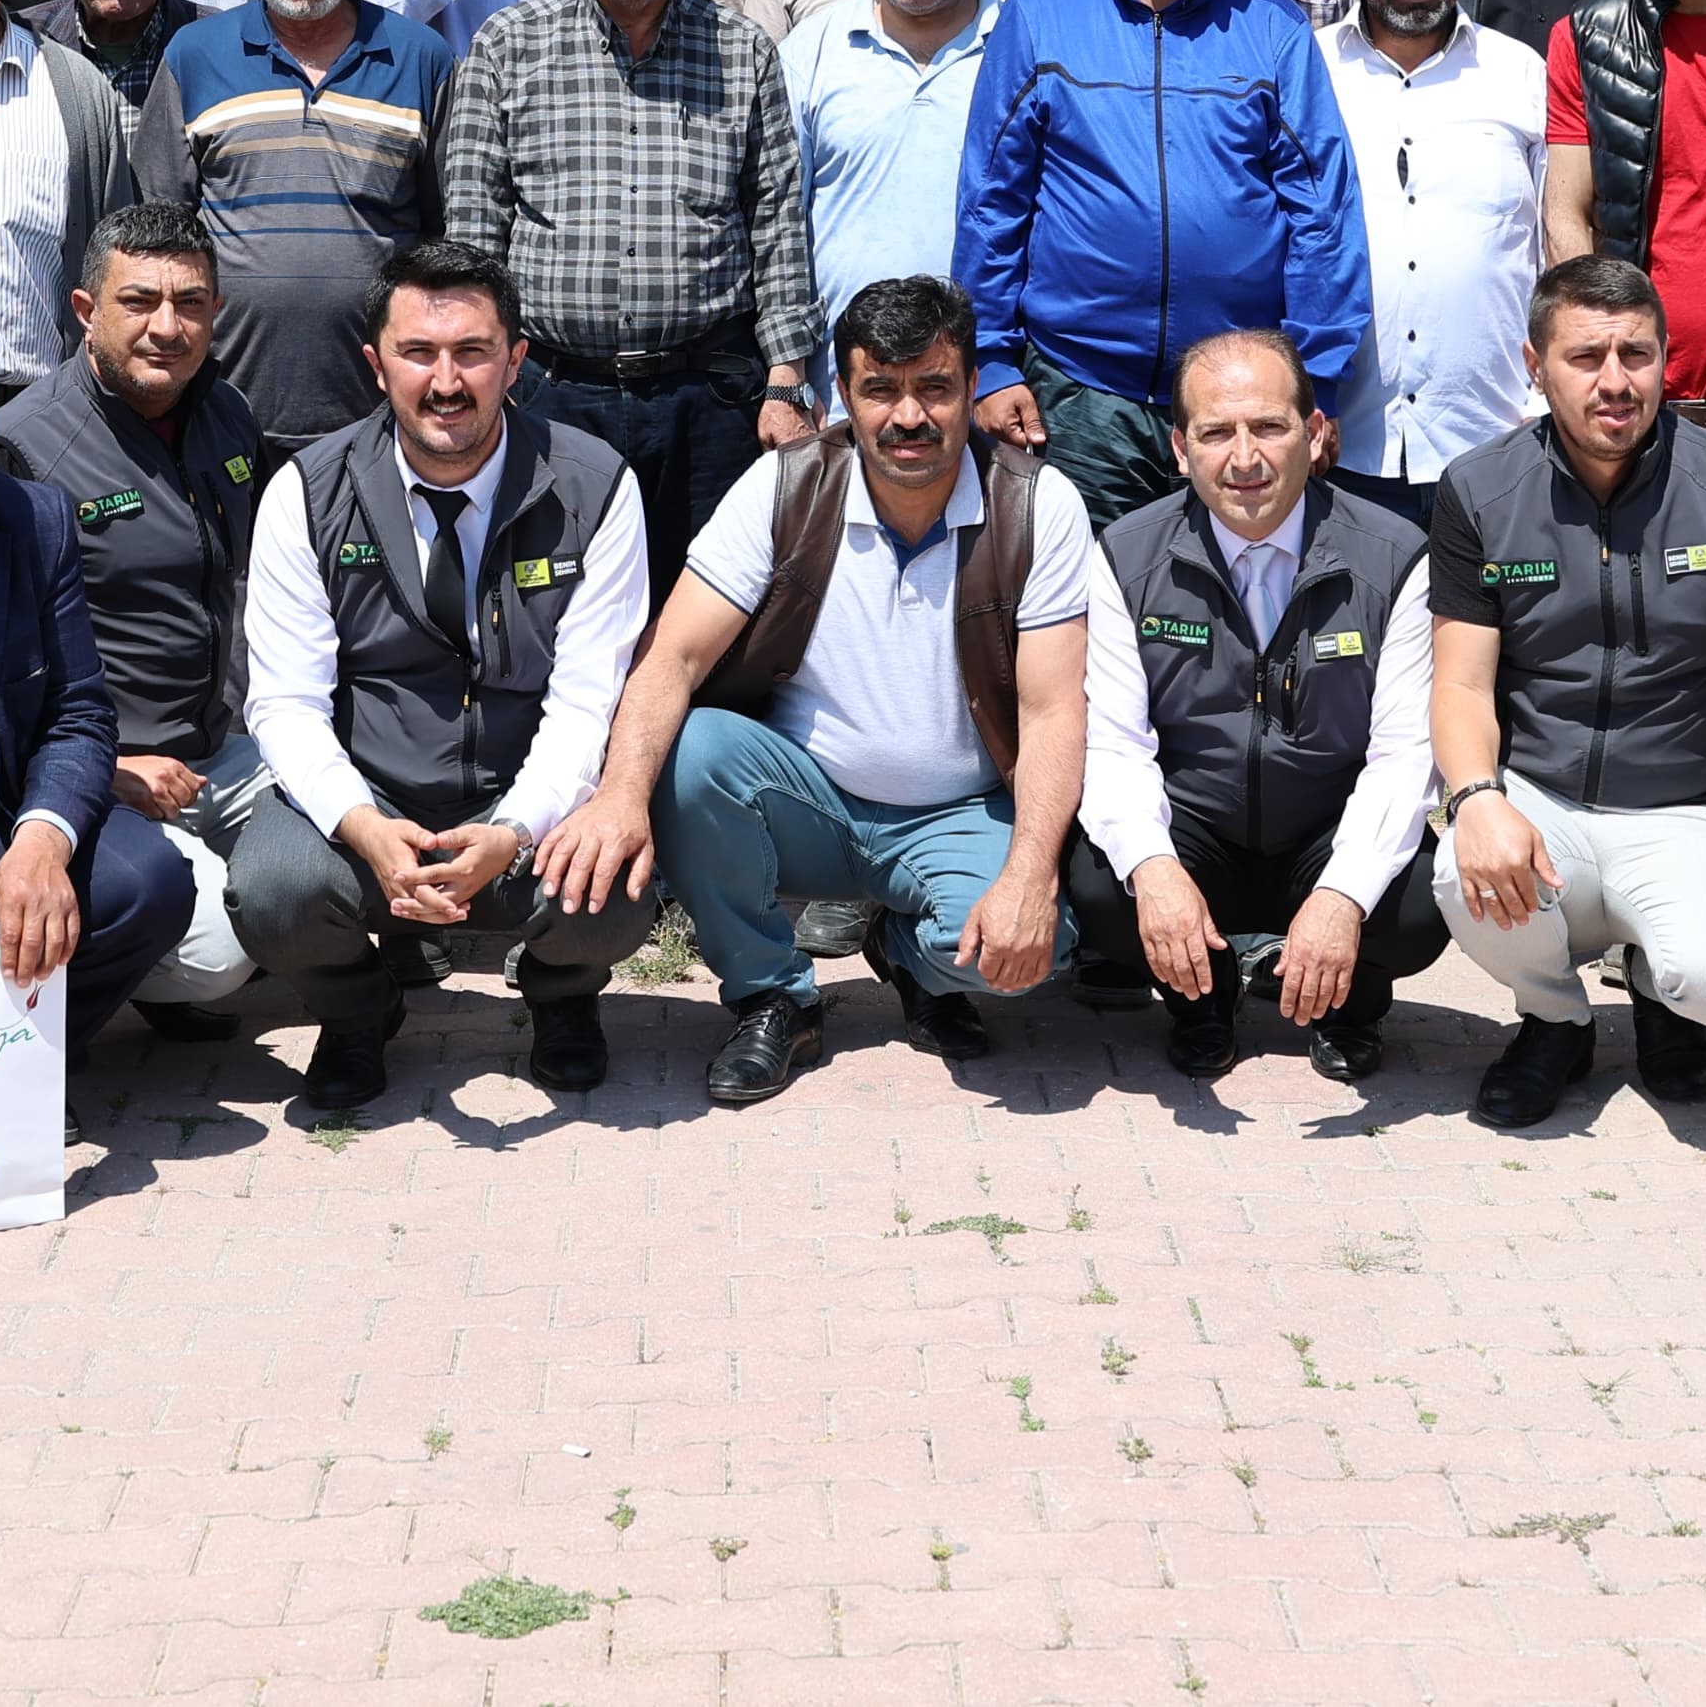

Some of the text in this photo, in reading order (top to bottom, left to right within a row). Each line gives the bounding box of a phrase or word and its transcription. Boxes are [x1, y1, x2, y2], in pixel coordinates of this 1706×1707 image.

[96, 490, 140, 510] TARIM
[1501, 561, 1555, 577] TARIM
[1162, 620, 1209, 637] TARIM
